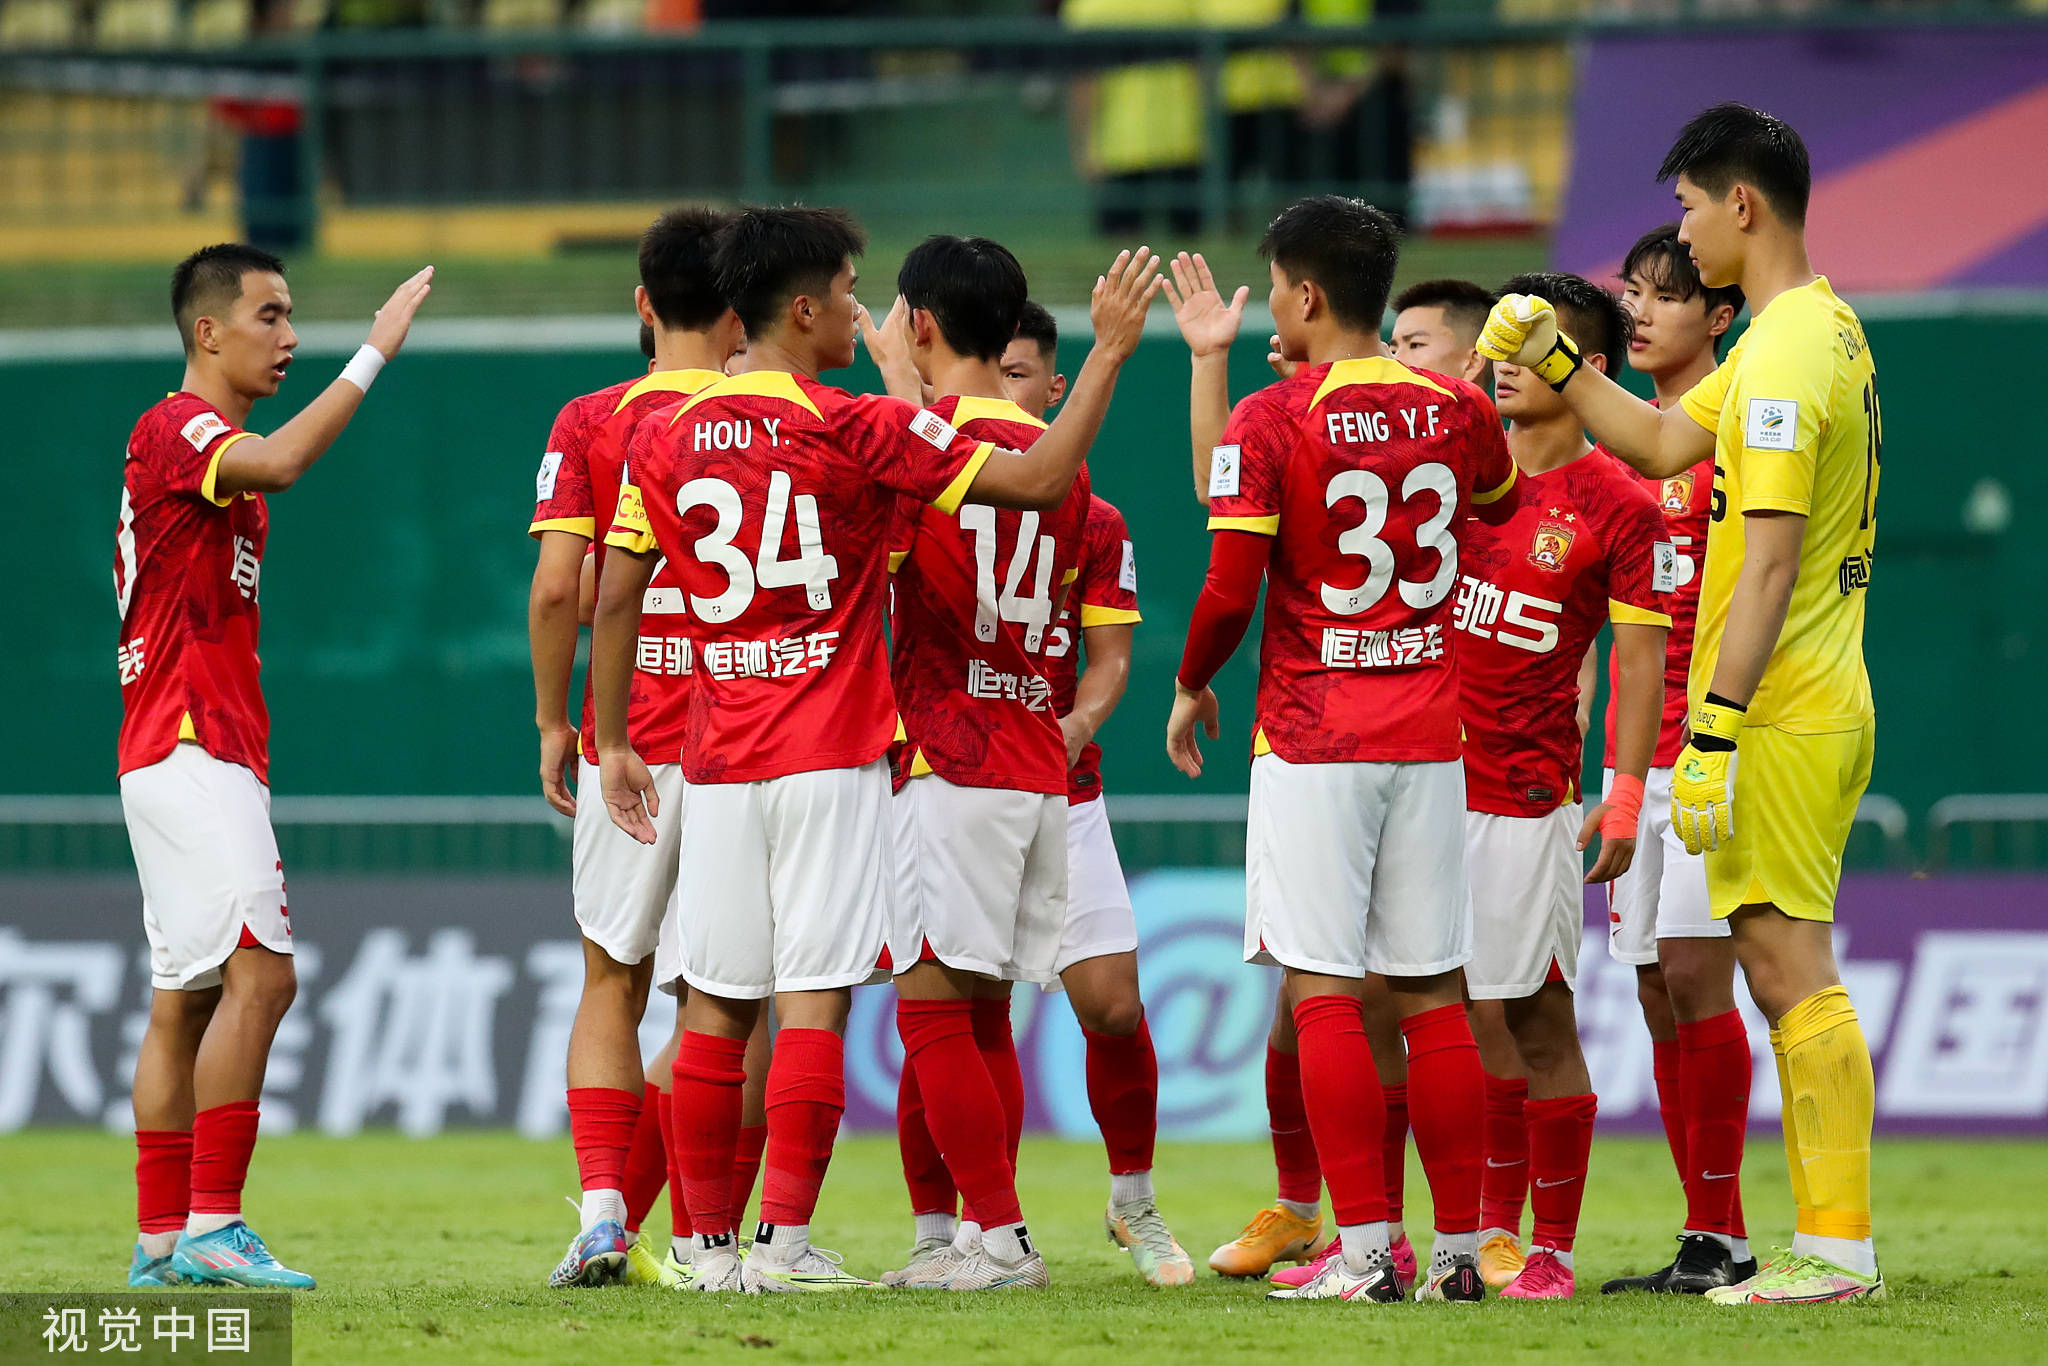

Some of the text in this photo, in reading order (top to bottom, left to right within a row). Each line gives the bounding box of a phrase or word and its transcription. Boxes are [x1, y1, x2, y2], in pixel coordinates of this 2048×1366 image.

[694, 418, 791, 451] HOU Y.
[1326, 405, 1449, 444] FENG Y.F.
[677, 470, 839, 624] 34
[1321, 462, 1458, 615] 33
[960, 504, 1055, 653] 14
[704, 630, 840, 681] 恒驰汽车
[1321, 624, 1444, 668] 恒驰汽车
